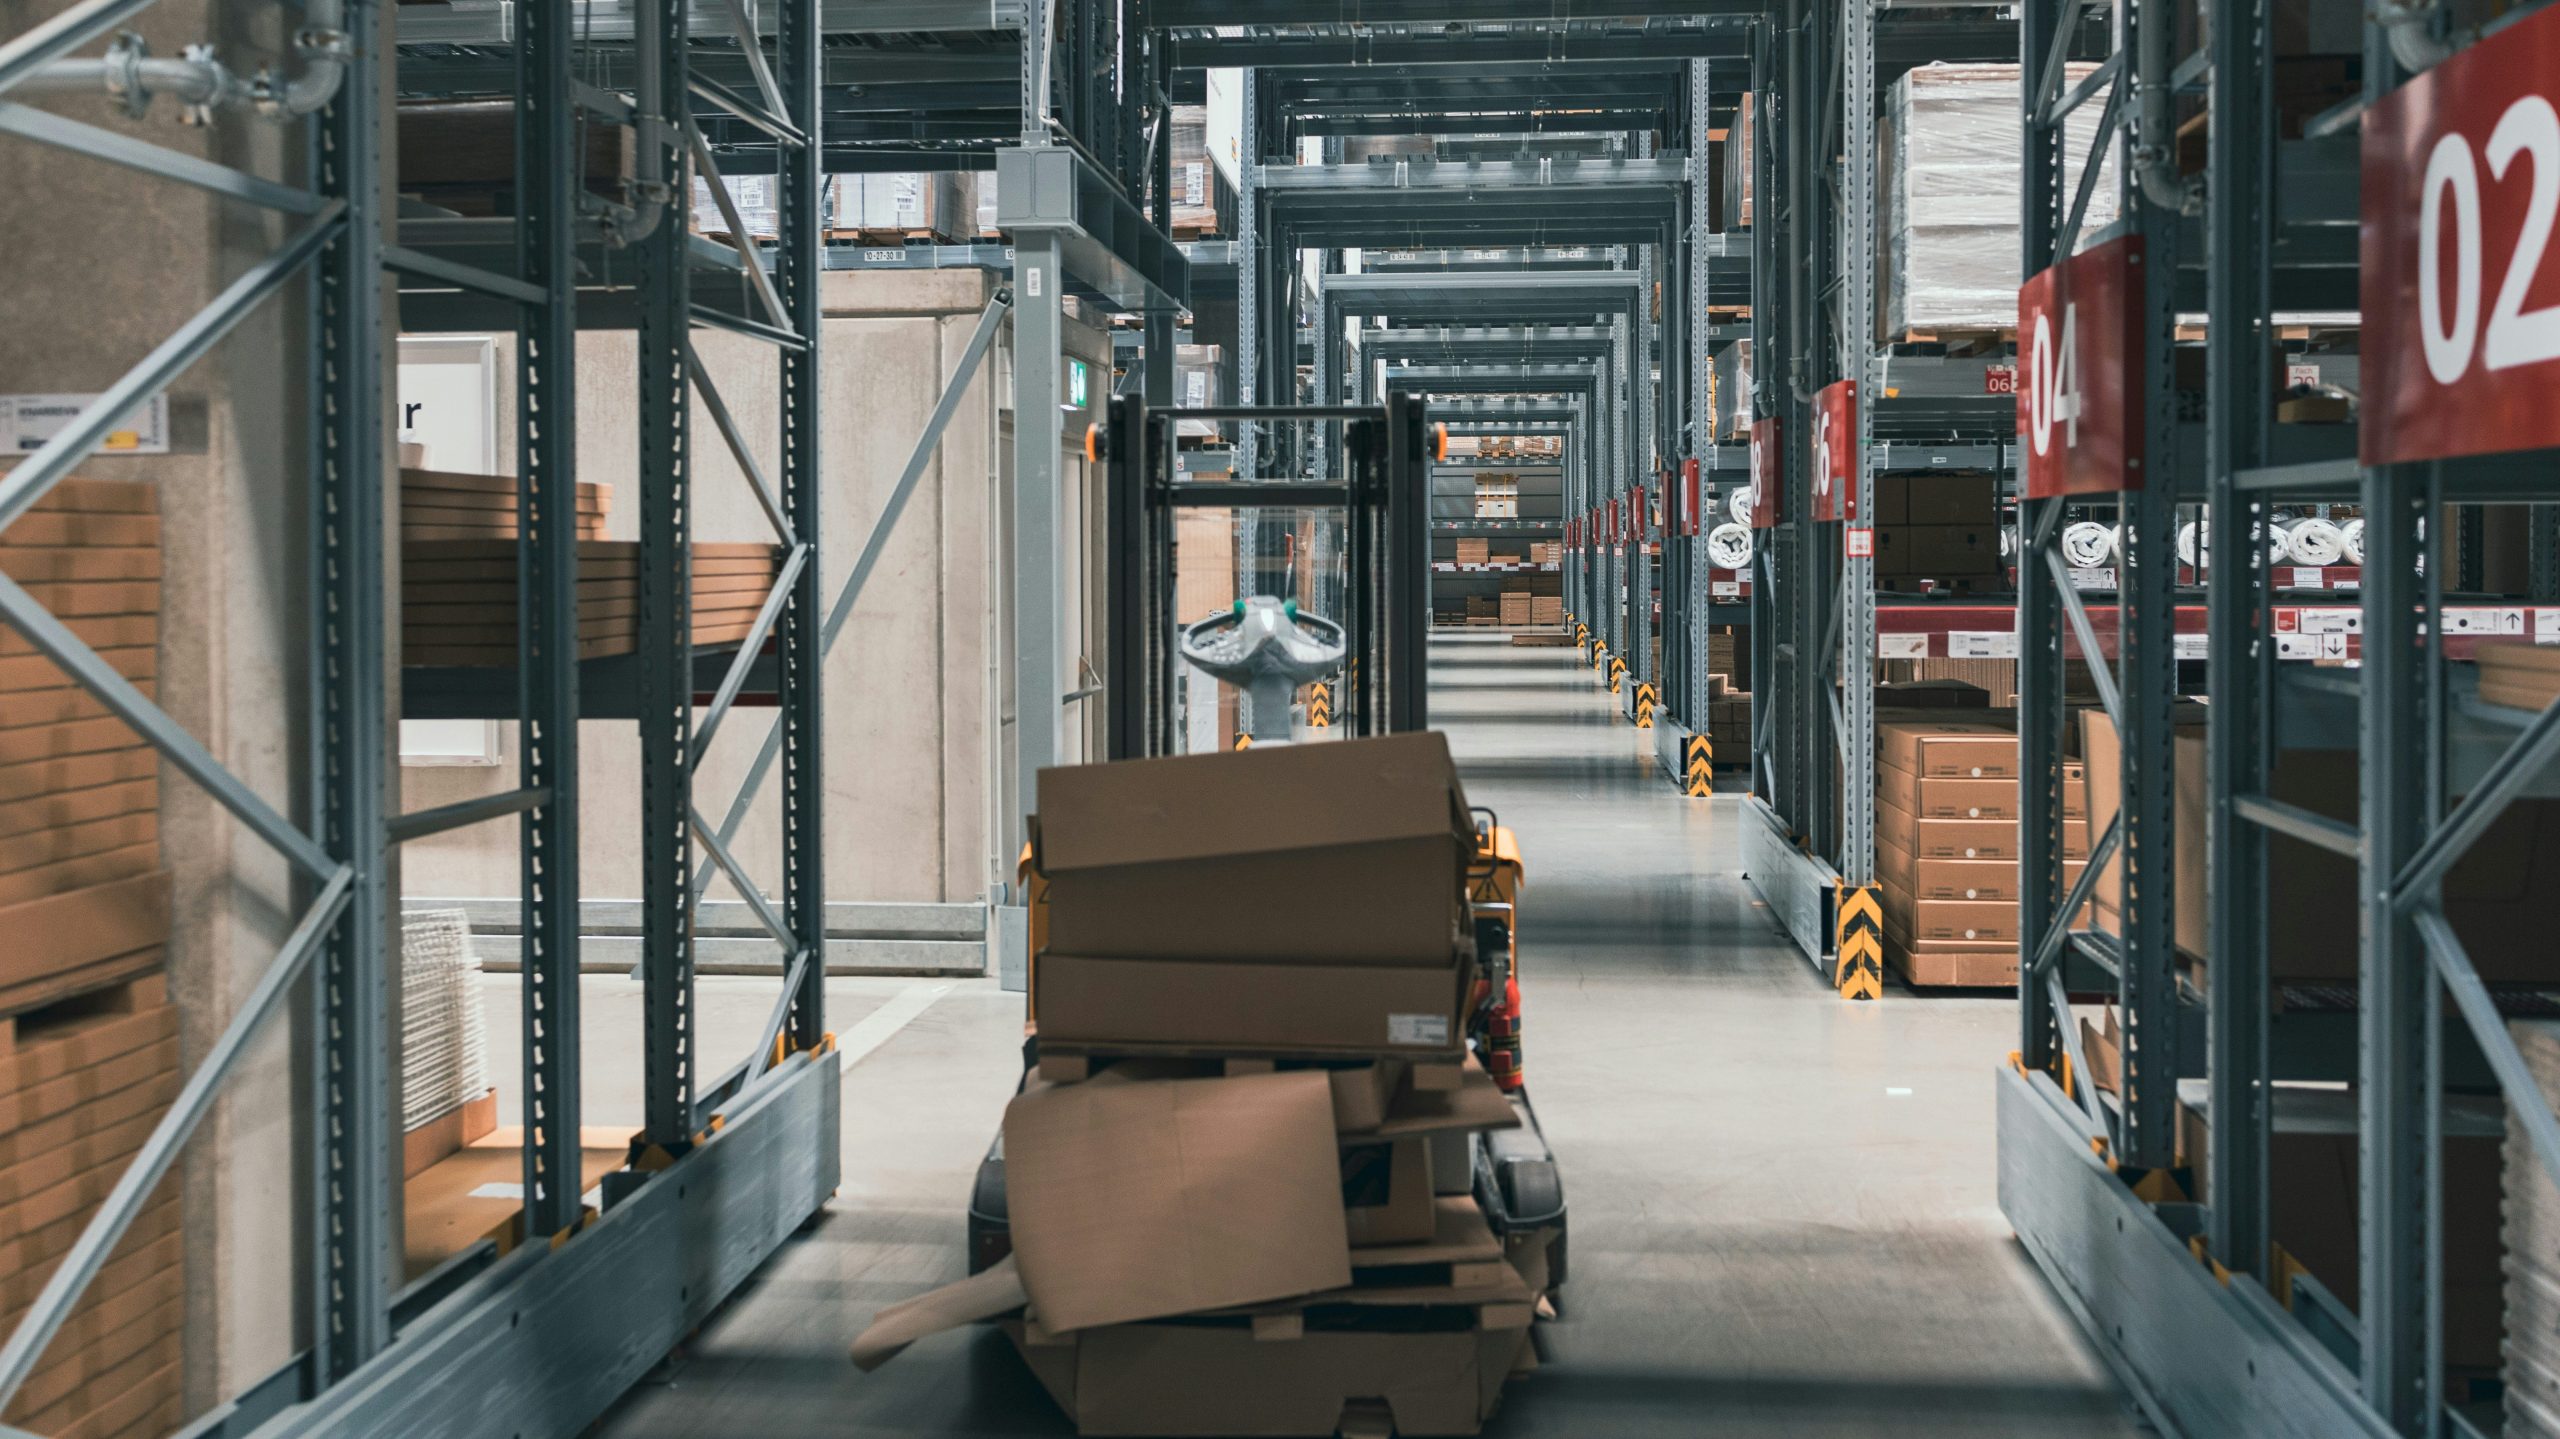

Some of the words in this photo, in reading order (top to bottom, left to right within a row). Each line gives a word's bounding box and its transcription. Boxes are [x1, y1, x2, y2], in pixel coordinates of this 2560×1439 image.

[2419, 94, 2560, 385] 02
[1988, 378, 2009, 392] 06
[2031, 302, 2082, 457] 04
